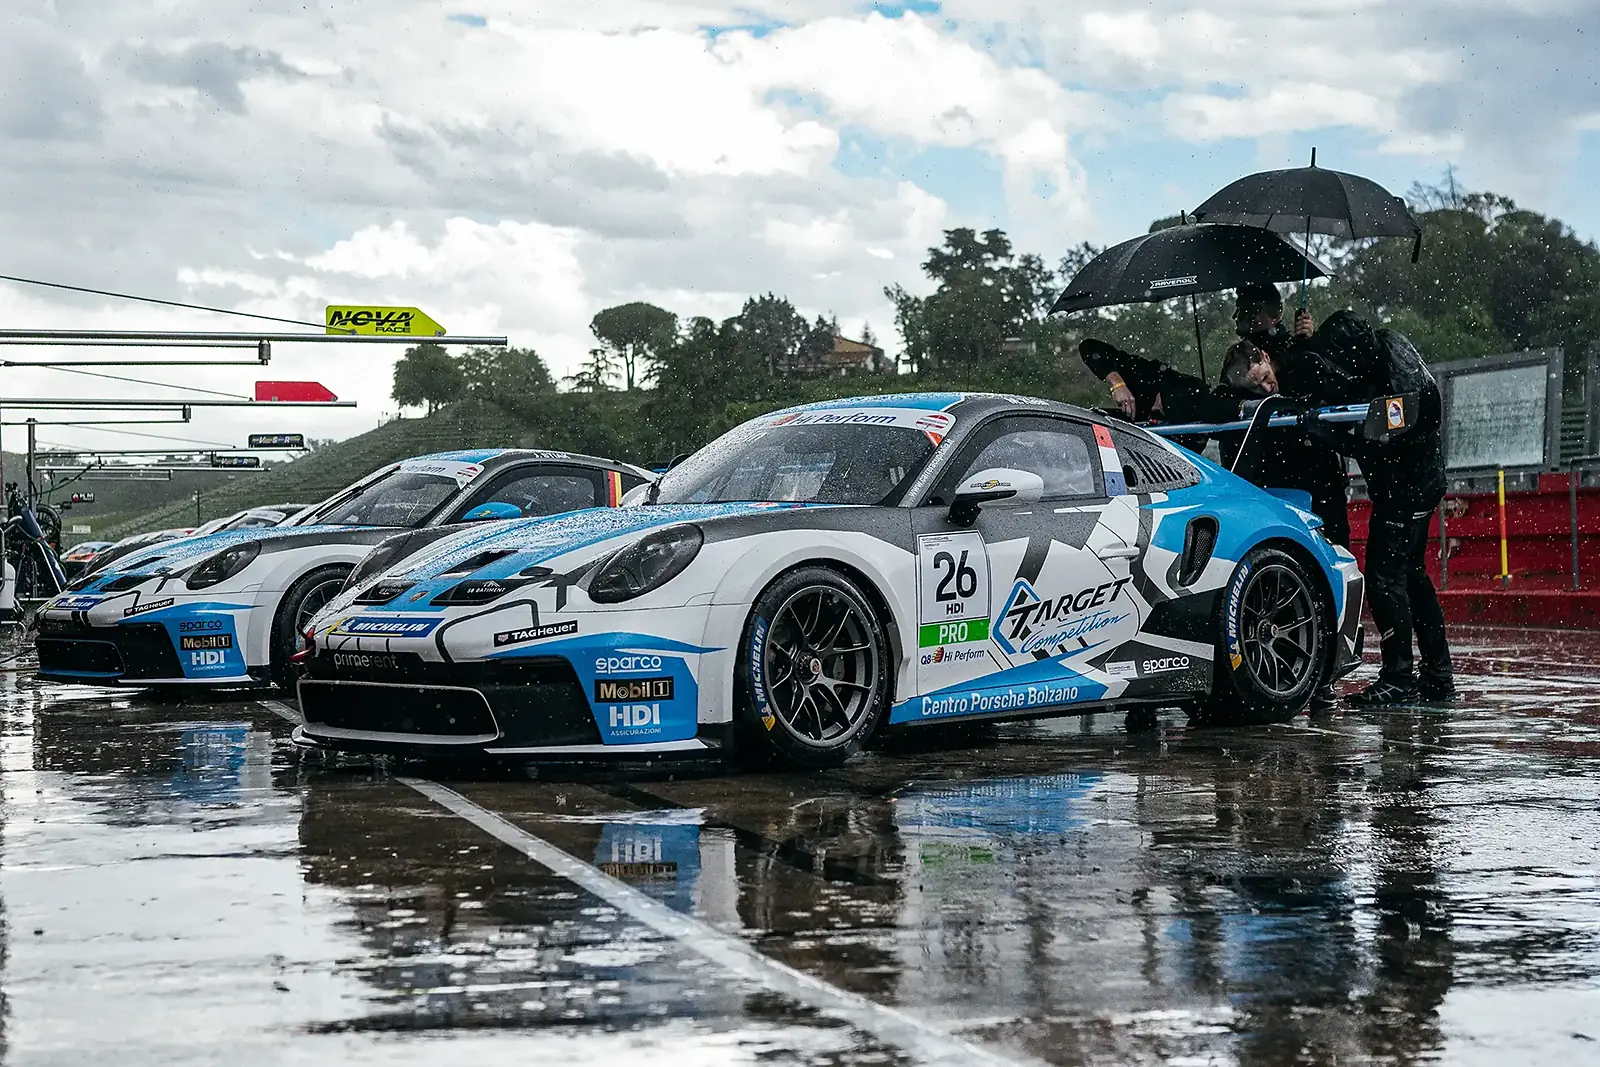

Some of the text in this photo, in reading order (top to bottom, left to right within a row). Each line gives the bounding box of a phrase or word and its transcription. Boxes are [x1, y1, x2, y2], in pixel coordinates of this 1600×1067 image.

[328, 310, 414, 326] NOVA
[813, 412, 898, 424] Perform
[933, 549, 978, 603] 26
[946, 602, 964, 615] HDI
[1006, 576, 1132, 640] TARGET
[1229, 564, 1249, 639] MICHELIN
[180, 620, 222, 632] sparco
[352, 623, 429, 632] MICHELIN
[939, 622, 968, 644] PRO
[183, 639, 215, 648] Mobil
[191, 651, 224, 665] HDI
[595, 656, 662, 674] sparco
[752, 625, 765, 702] MICHELIN
[920, 654, 931, 665] Q8
[954, 649, 984, 661] Perform
[1142, 656, 1189, 674] sparco
[600, 681, 650, 699] Mobil
[921, 685, 1079, 715] Centro Porsche Bolzano
[609, 703, 660, 727] HDI
[610, 728, 661, 736] ASSICURAZIONI
